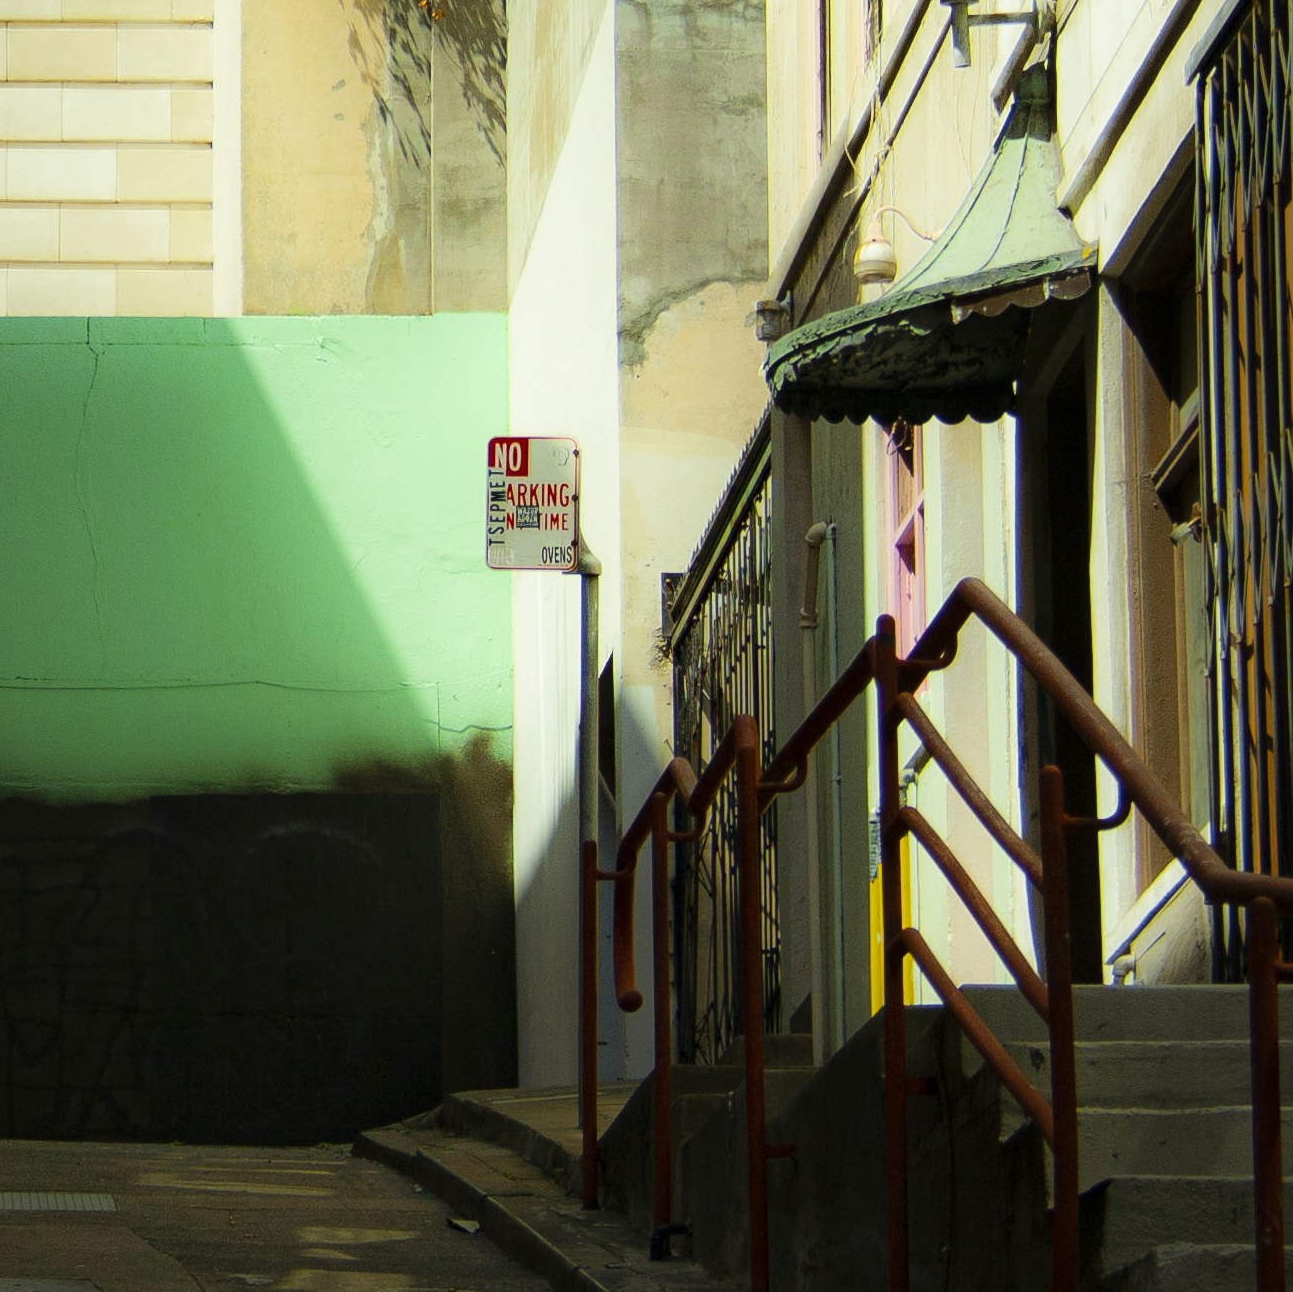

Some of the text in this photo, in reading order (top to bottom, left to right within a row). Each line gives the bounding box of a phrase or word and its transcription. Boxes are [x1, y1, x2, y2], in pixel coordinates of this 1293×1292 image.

[494, 442, 522, 472] NO
[506, 483, 570, 507] ARKING
[506, 512, 569, 531] NTIME
[541, 546, 573, 564] OVENS
